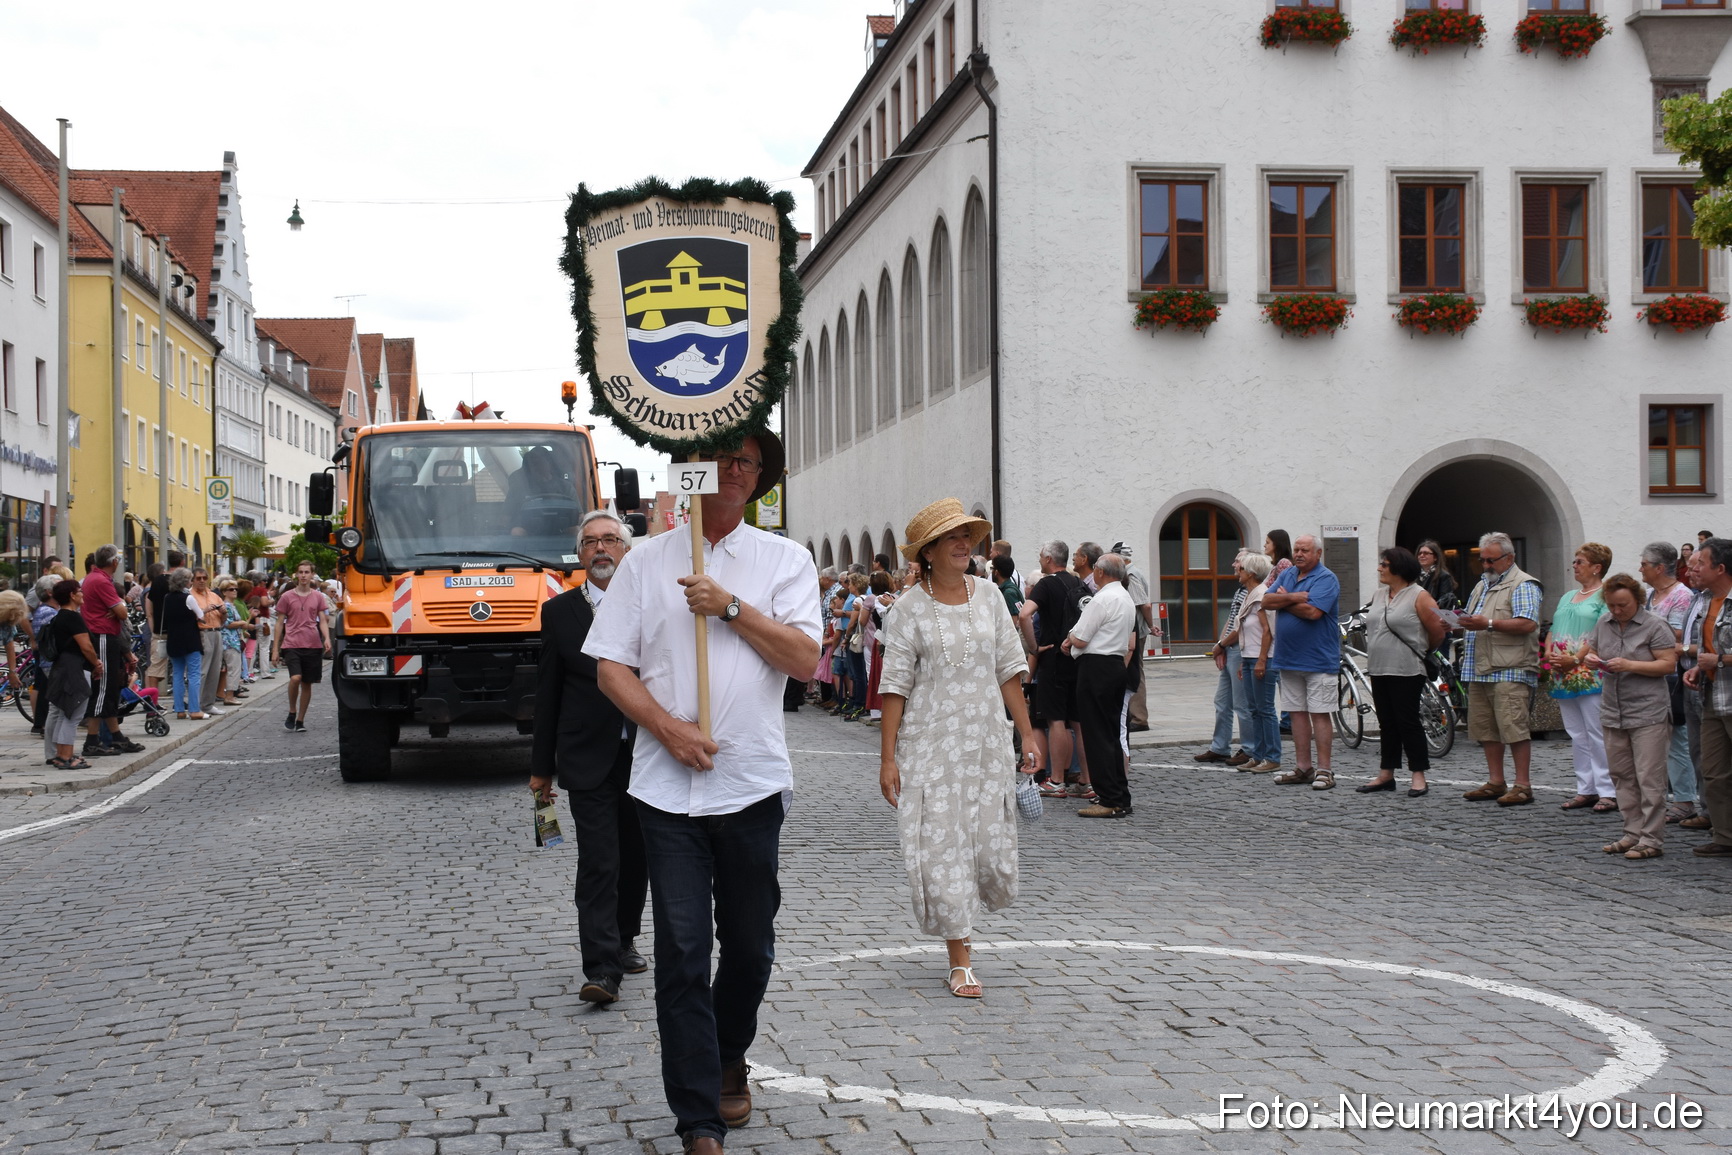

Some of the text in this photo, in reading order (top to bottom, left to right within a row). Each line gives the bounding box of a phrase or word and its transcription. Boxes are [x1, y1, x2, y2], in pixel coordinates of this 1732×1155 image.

[633, 205, 653, 231] und
[680, 471, 707, 490] 57
[452, 576, 513, 586] SAD L 2010
